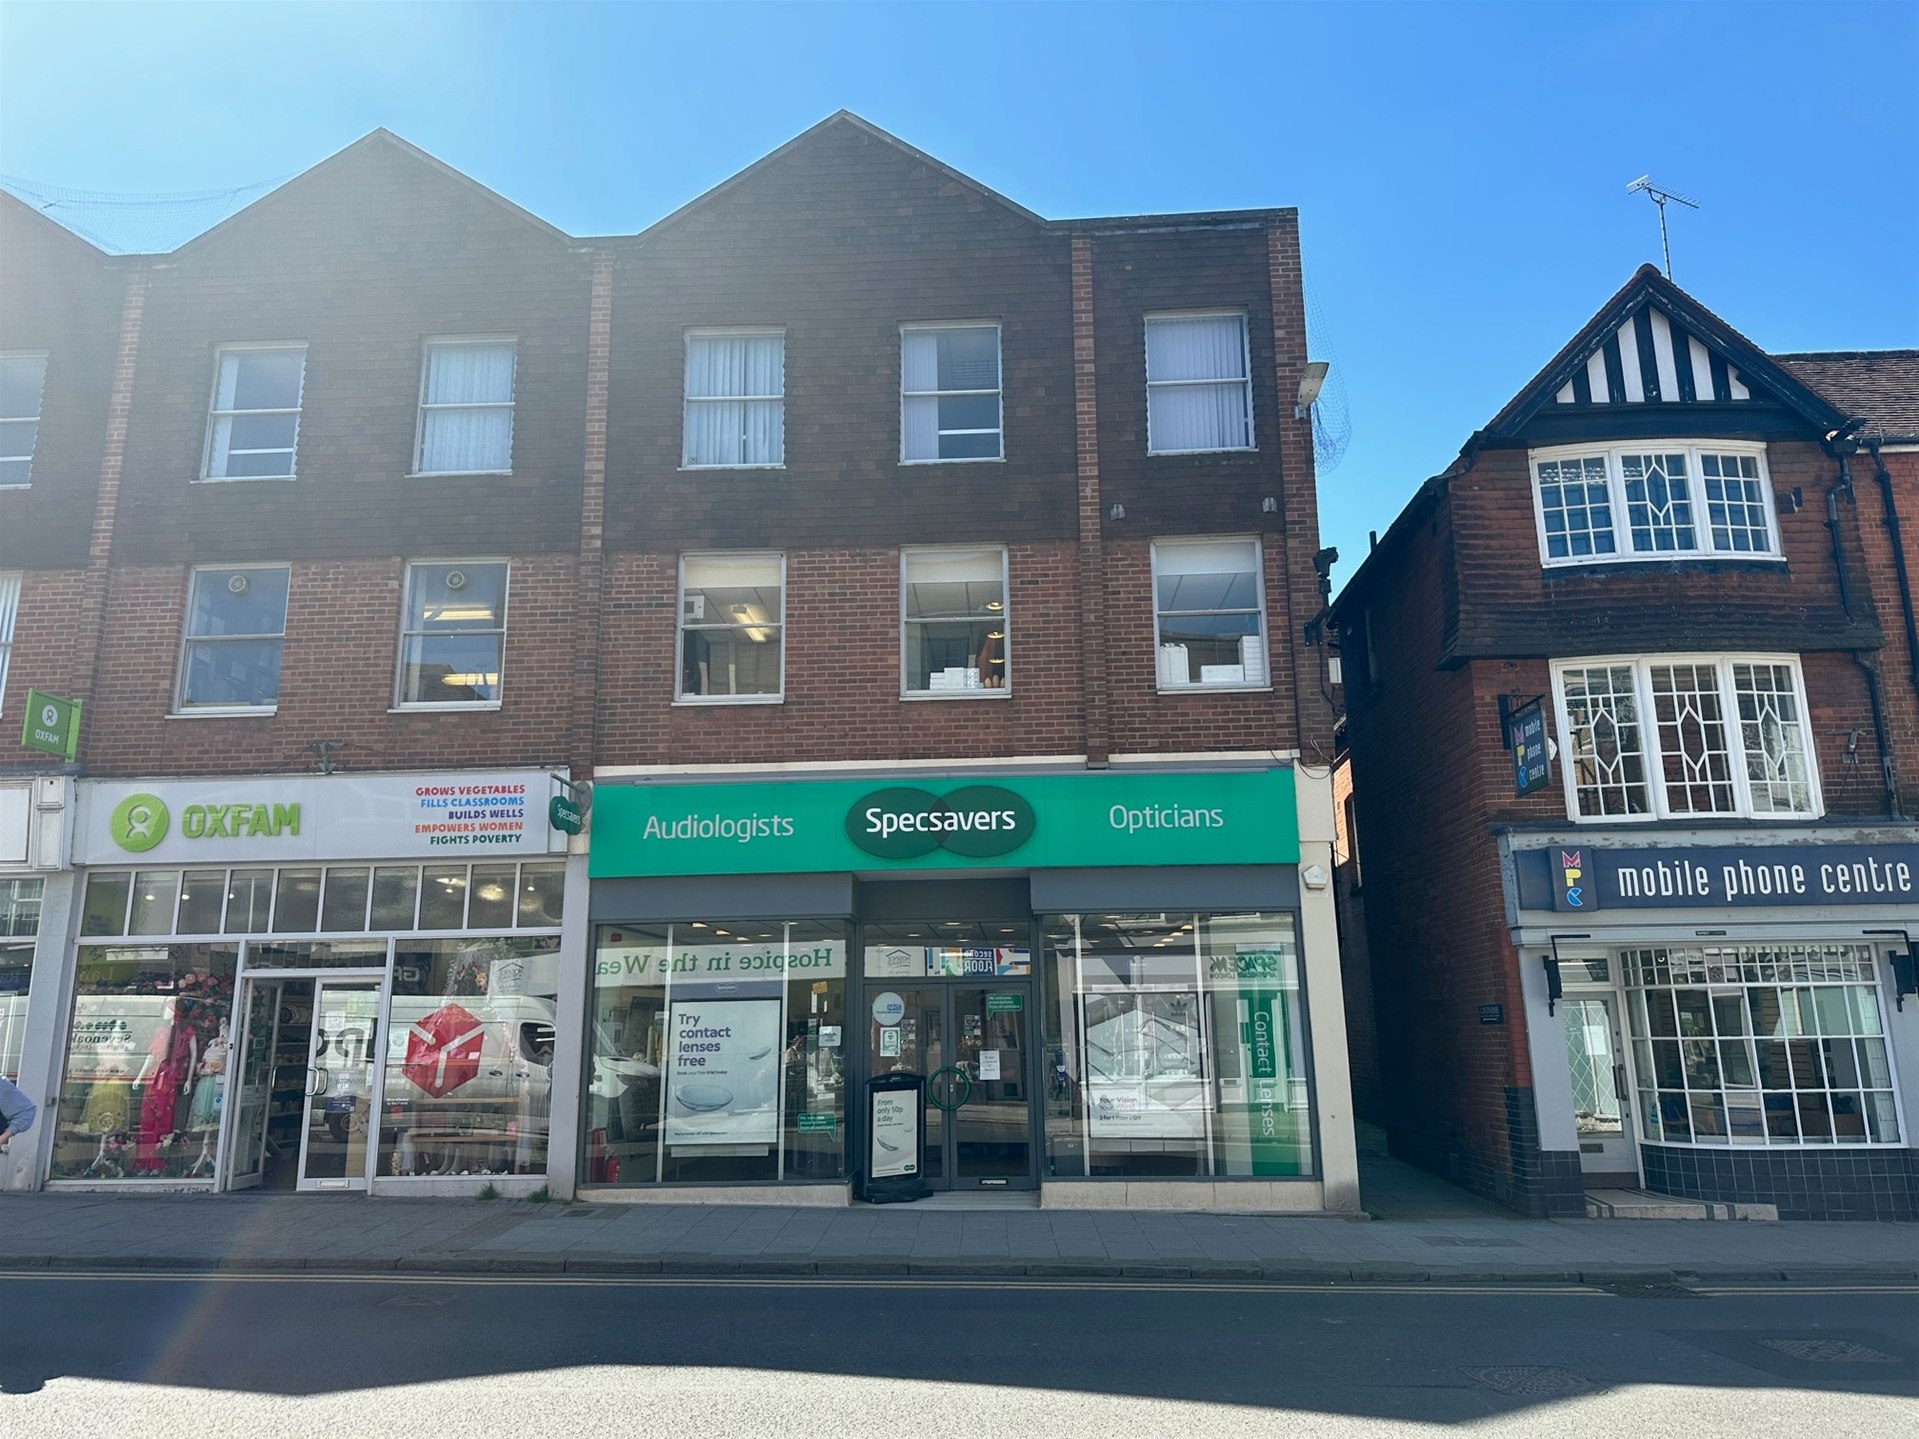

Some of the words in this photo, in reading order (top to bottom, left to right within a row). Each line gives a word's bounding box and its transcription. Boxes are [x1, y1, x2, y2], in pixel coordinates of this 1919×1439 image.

[1525, 719, 1540, 737] mobile
[35, 729, 59, 744] OXFAM
[1527, 743, 1541, 761] phone
[1529, 764, 1545, 781] centre
[416, 786, 455, 797] GROWS
[459, 784, 525, 796] VEGETABLES
[420, 798, 448, 808] FILLS
[451, 797, 525, 807] CLASSROOMS
[182, 802, 300, 839] OXFAM
[448, 810, 486, 820] BUILDS
[489, 808, 524, 819] WELLS
[557, 803, 581, 826] Specsavers
[1109, 804, 1224, 834] Opticians
[415, 823, 476, 833] EMPOWERS
[479, 821, 523, 832] WOMEN
[643, 812, 794, 843] Audiologists
[865, 807, 1016, 838] Specsavers
[430, 835, 470, 845] FIGHTS
[473, 834, 522, 844] POVERTY
[1617, 860, 1710, 897] mobile
[1722, 859, 1806, 902] phone
[1820, 856, 1912, 894] centre
[678, 1013, 701, 1027] Try
[679, 1026, 731, 1038] contact
[678, 1041, 721, 1053] lenses
[1254, 1011, 1272, 1073] Contact
[677, 1056, 706, 1067] free
[877, 1107, 890, 1115] only
[892, 1106, 904, 1114] 50p
[1260, 1080, 1275, 1136] Lenses
[882, 1115, 893, 1123] day
